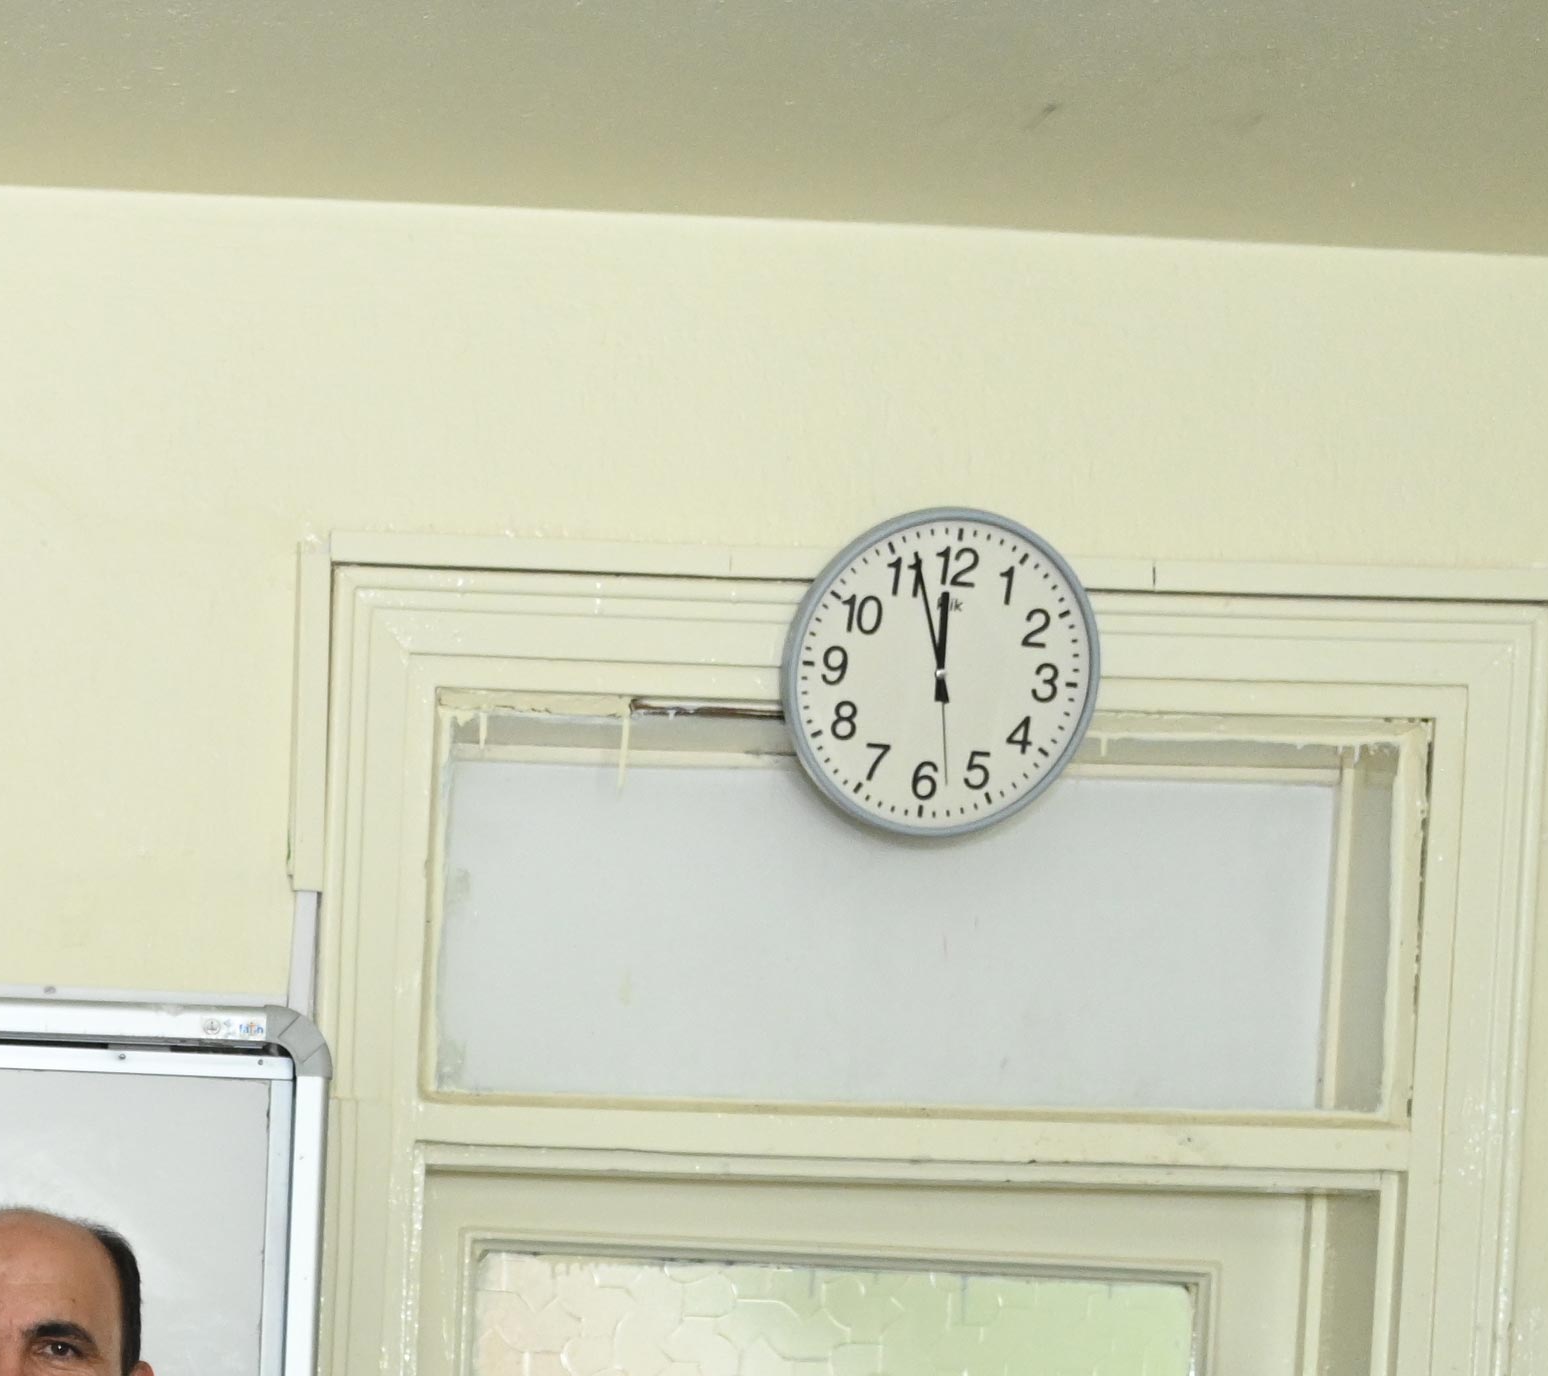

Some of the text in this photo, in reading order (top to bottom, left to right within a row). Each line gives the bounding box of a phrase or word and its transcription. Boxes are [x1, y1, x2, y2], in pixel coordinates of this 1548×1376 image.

[887, 557, 923, 598] 11
[936, 546, 979, 587] 12
[1000, 566, 1015, 605] 1
[842, 594, 883, 635] 10
[1021, 609, 1050, 648] 2
[821, 646, 848, 685] 9
[1031, 663, 1059, 703] 3
[830, 701, 857, 740] 8
[1006, 716, 1032, 754] 4
[866, 743, 891, 780] 7
[911, 761, 938, 800] 6
[963, 751, 990, 790] 5
